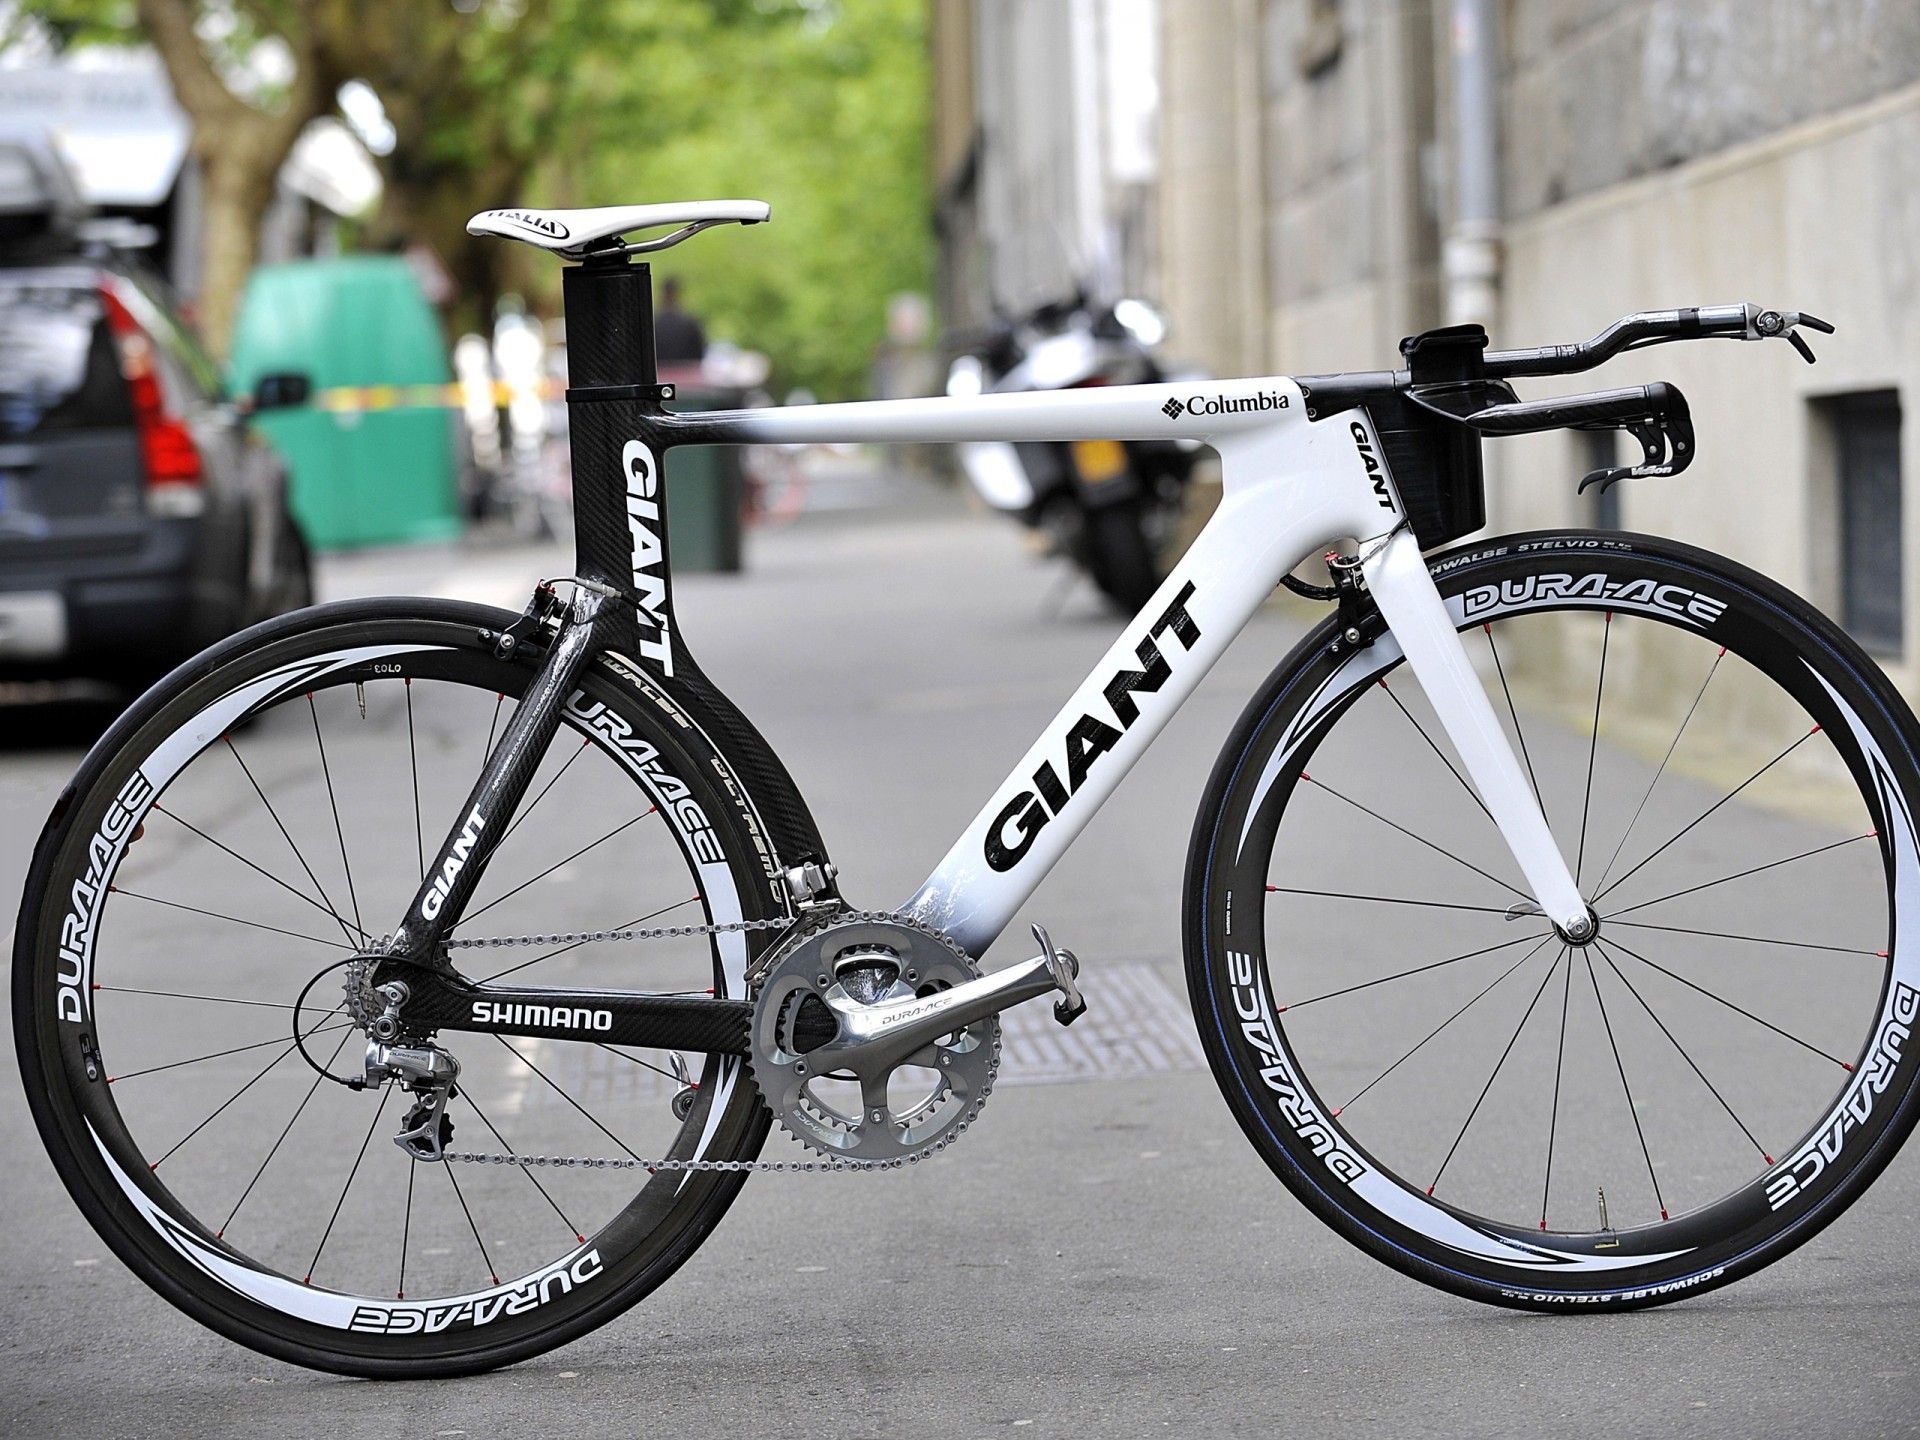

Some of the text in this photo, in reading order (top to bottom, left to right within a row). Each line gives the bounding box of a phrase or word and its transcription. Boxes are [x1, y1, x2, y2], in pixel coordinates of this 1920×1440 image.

[1186, 391, 1290, 416] Columbia
[1349, 421, 1397, 514] GIANT
[1631, 465, 1673, 476] Vision
[622, 439, 674, 678] GIANT
[1430, 546, 1508, 576] HWALBE
[1517, 540, 1600, 553] STELVIO
[1465, 573, 1729, 625] DURA-ACE
[374, 663, 402, 674] 0703
[984, 579, 1201, 873] GIANT
[565, 688, 726, 863] URA-ACE
[421, 802, 487, 921] GIANT
[57, 770, 151, 1023] DURA-ACE
[472, 1002, 613, 1031] SHIMANO
[881, 996, 953, 1026] DURA-ACE
[1226, 950, 1365, 1184] DURA-ACE
[1765, 984, 1920, 1212] DURA-ACE
[350, 1248, 604, 1335] DURA-ACE
[1534, 1294, 1614, 1304] STELVIO
[1621, 1267, 1725, 1301] SCHWALBE
